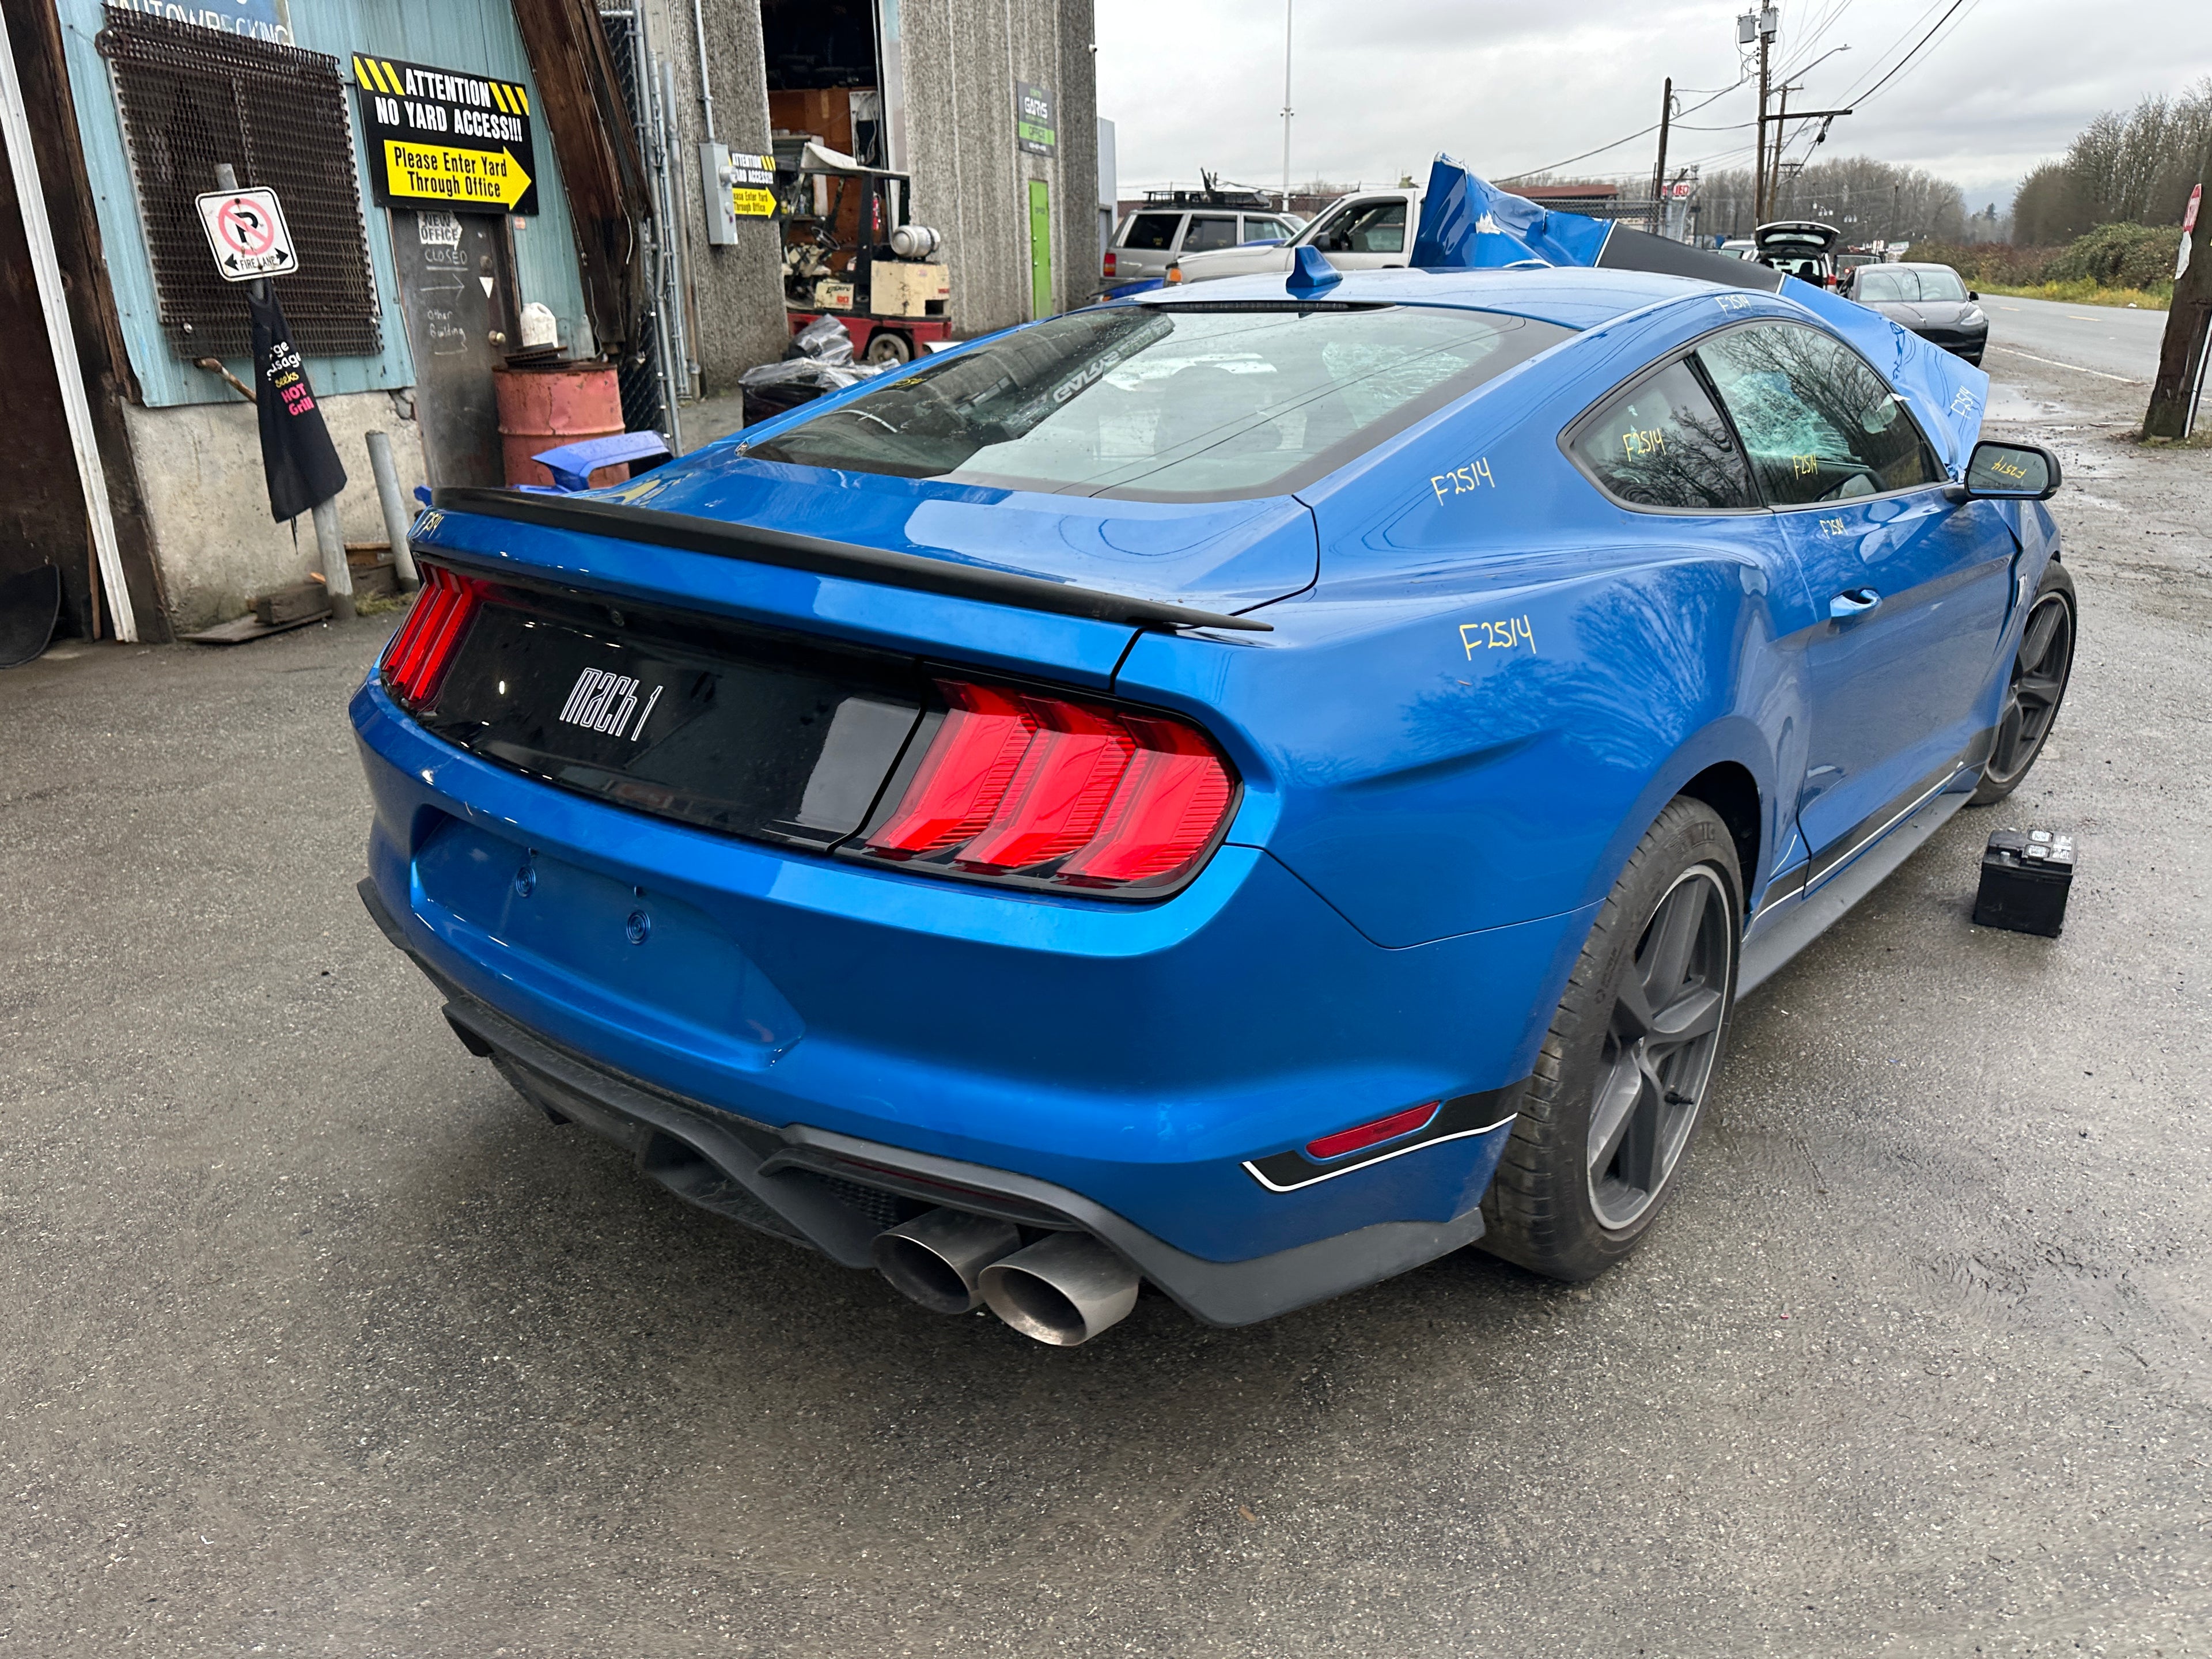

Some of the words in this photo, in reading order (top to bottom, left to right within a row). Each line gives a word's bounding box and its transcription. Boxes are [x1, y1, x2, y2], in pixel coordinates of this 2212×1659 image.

[406, 68, 491, 108] ATTENTION
[375, 97, 400, 126] NO
[404, 101, 448, 132] YARD
[454, 109, 522, 142] ACCESS!!!
[394, 146, 438, 171] Please
[443, 152, 476, 173] Enter
[481, 156, 507, 177] Yard
[732, 153, 762, 169] ATTENTION
[407, 171, 460, 197] Through
[465, 175, 501, 197] Office
[745, 191, 756, 201] Enter
[758, 192, 768, 202] Yard
[753, 202, 766, 212] Office
[425, 213, 450, 226] NEW
[421, 225, 459, 241] OFFICE
[240, 258, 256, 270] FIRE
[425, 248, 467, 265] CLOSED
[1714, 294, 1752, 316] F2514
[281, 382, 306, 403] HOT
[289, 396, 315, 415] Grill
[1622, 427, 1667, 462] F2514
[1793, 454, 1818, 480] F2514
[1430, 457, 1495, 506] F2514
[1819, 517, 1849, 539] F2514
[1459, 614, 1536, 661] F2514
[630, 685, 664, 741] 1
